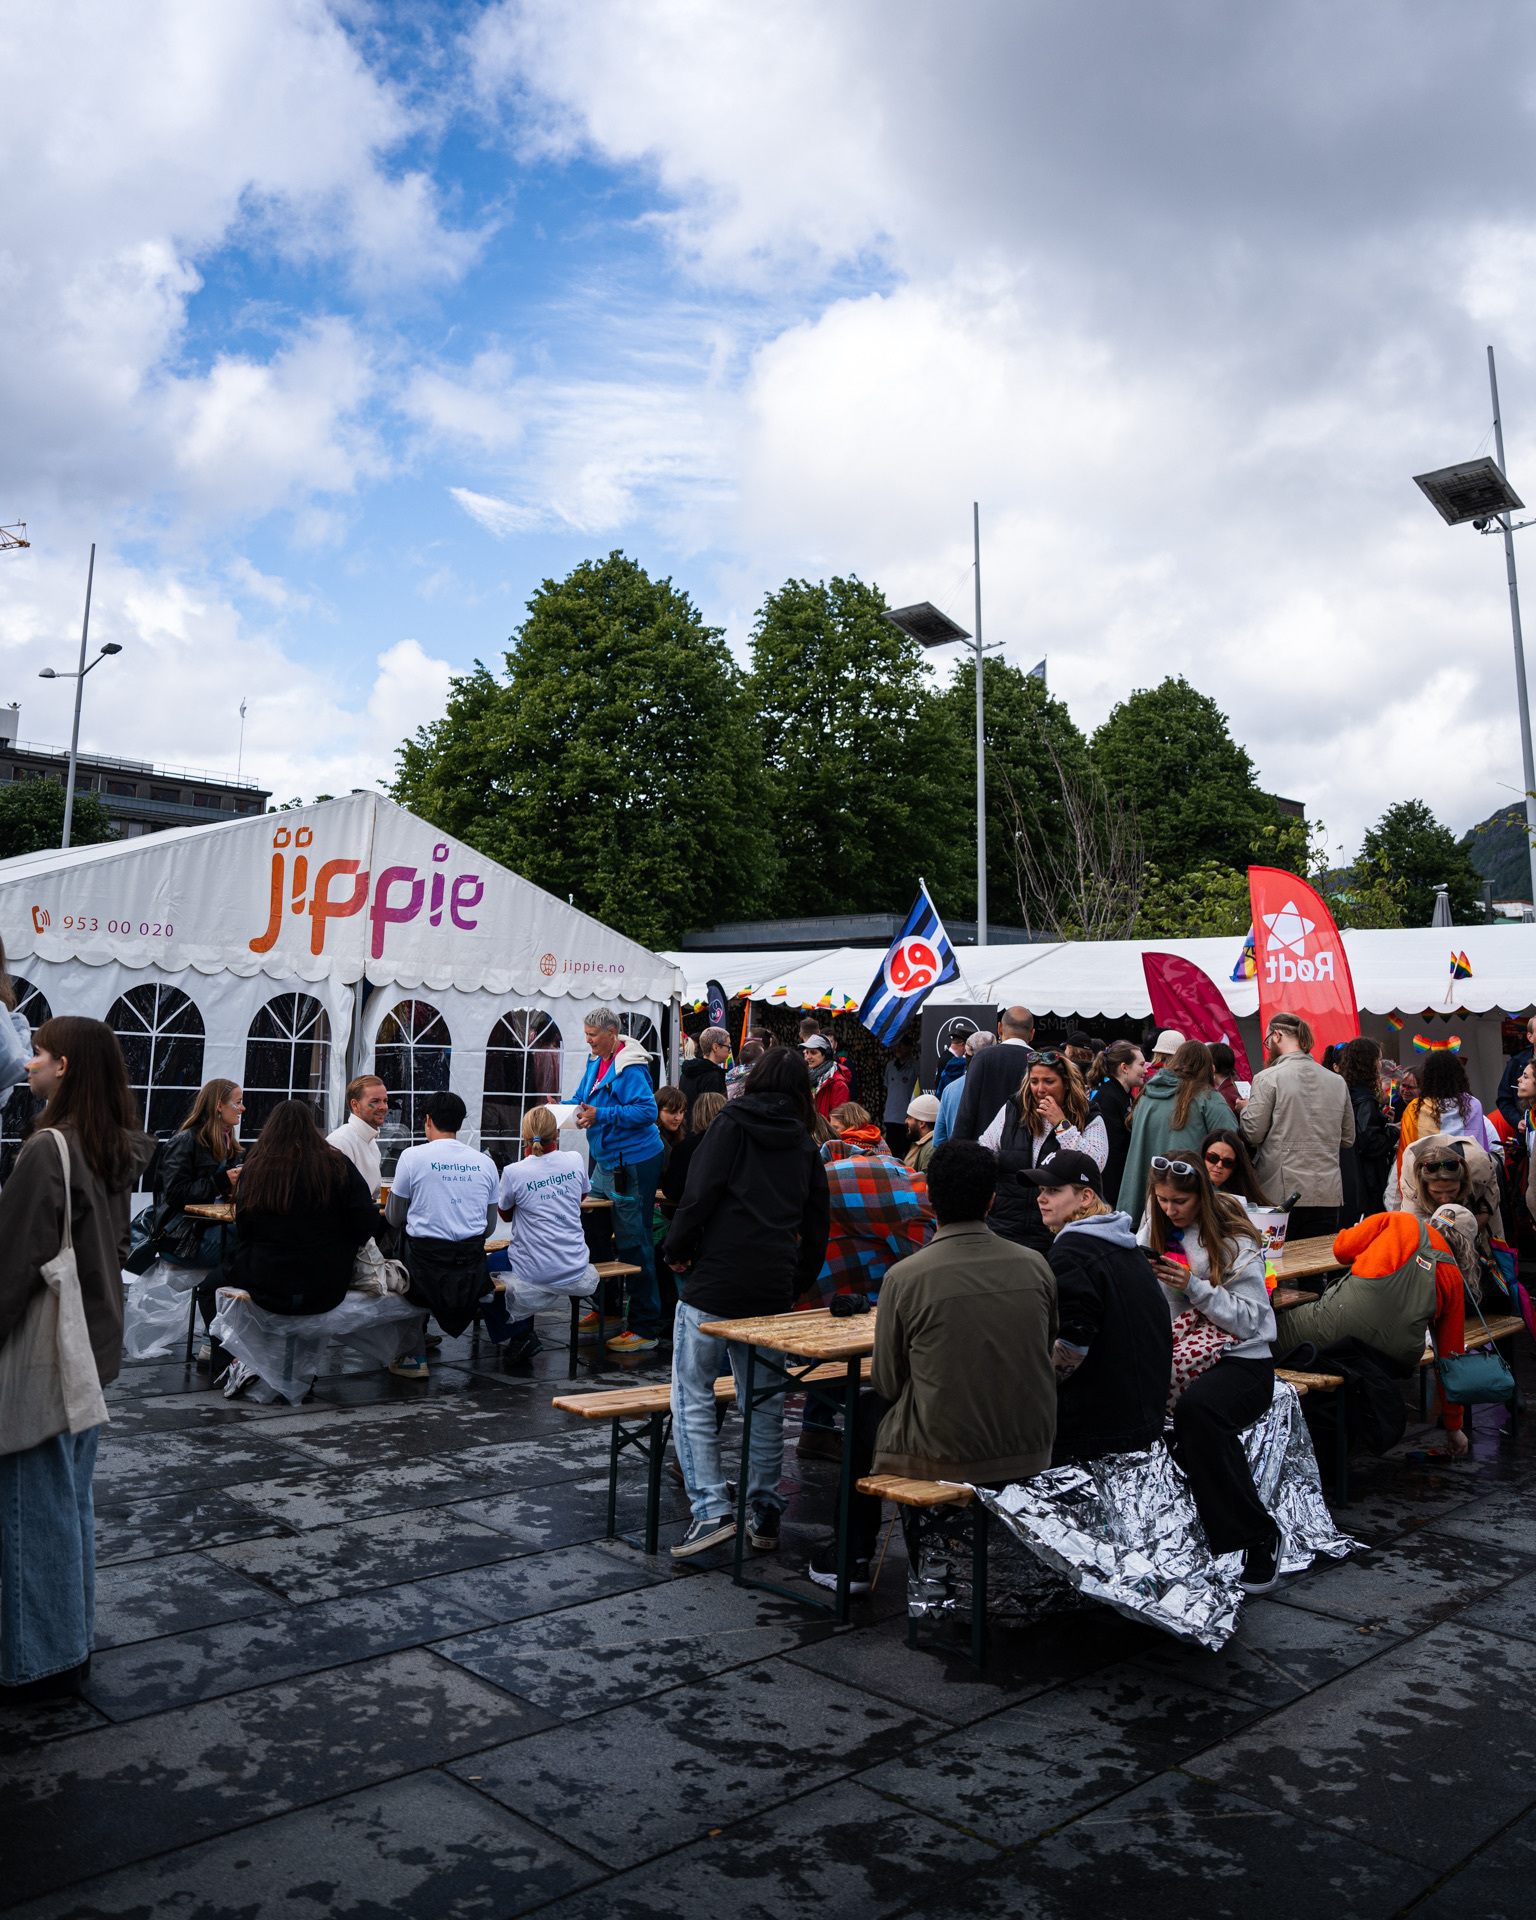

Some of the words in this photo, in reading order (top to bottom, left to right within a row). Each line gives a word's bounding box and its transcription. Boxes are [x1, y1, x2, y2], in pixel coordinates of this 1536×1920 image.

[249, 827, 484, 960] jippie
[63, 915, 98, 932] 953
[108, 920, 131, 934] 00
[139, 922, 174, 937] 020
[562, 959, 625, 974] jippie.no
[431, 1162, 481, 1173] Kjærlighet
[467, 1174, 473, 1182] Å
[526, 1170, 576, 1192] Kjærlighet
[540, 1193, 551, 1201] fra
[551, 1191, 557, 1199] A
[564, 1185, 570, 1195] Å
